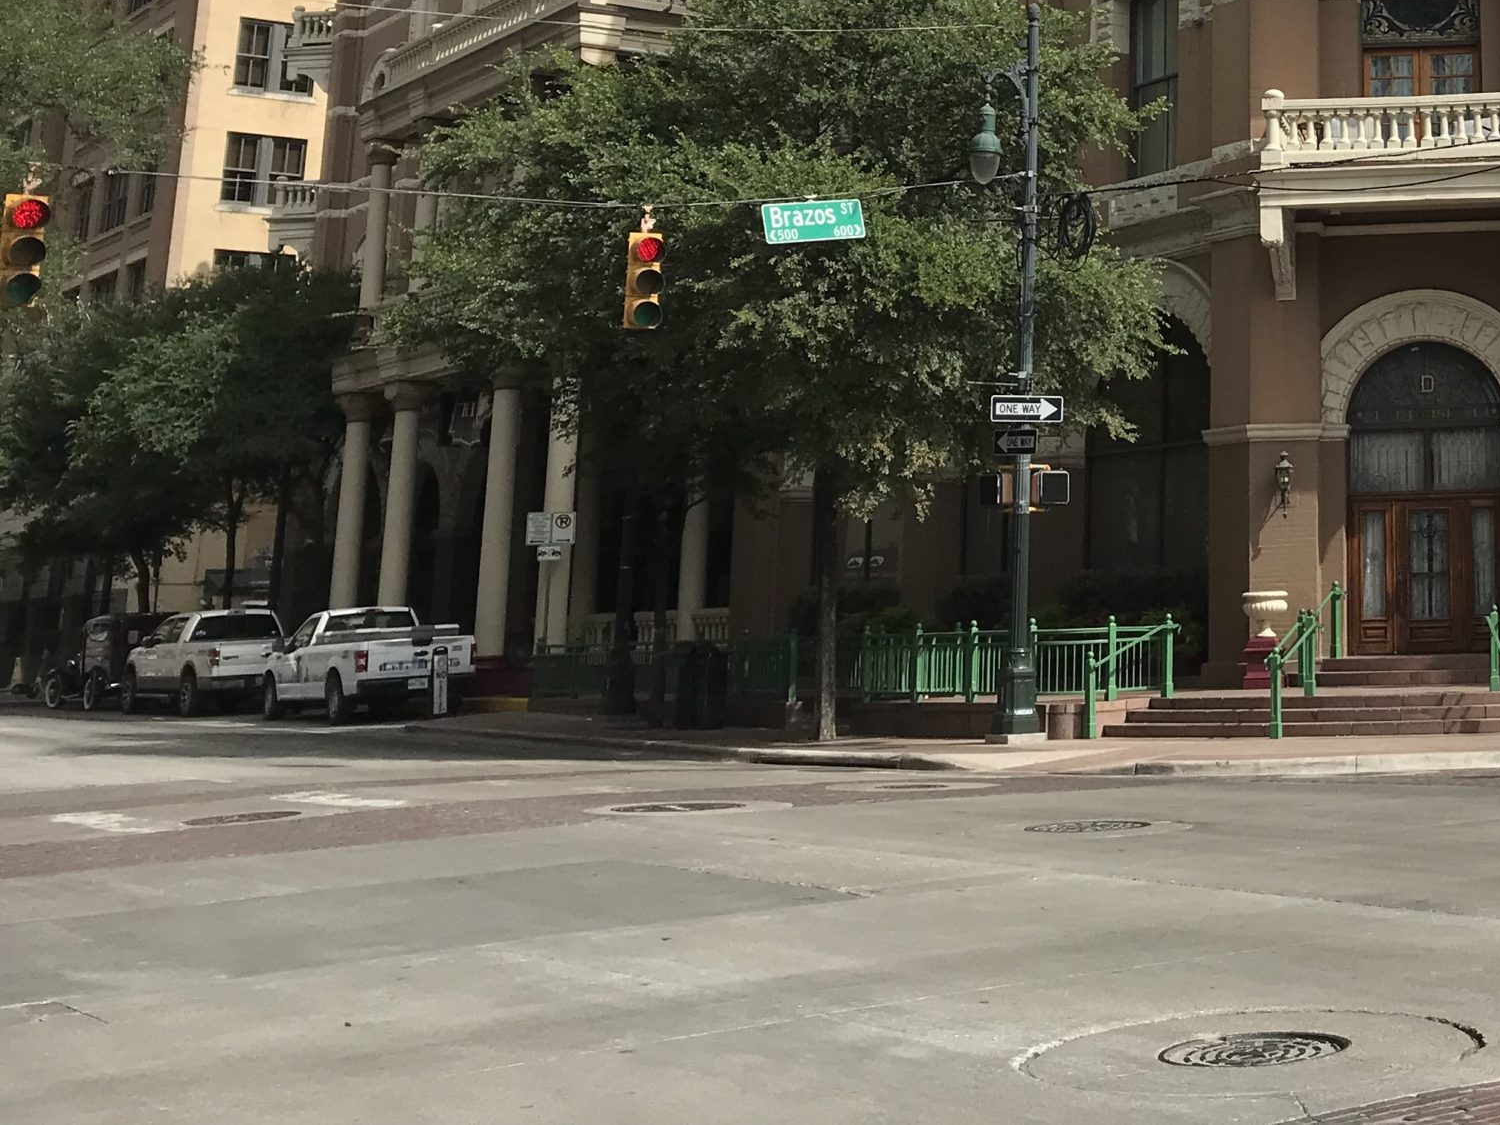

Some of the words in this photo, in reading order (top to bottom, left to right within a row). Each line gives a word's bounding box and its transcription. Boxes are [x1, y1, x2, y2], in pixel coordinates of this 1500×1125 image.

[769, 207, 836, 228] Brazos
[840, 202, 853, 215] ST
[777, 228, 798, 240] 500
[833, 225, 854, 236] 600
[1421, 375, 1434, 393] D
[999, 404, 1018, 413] ONE
[1022, 404, 1041, 413] WAY
